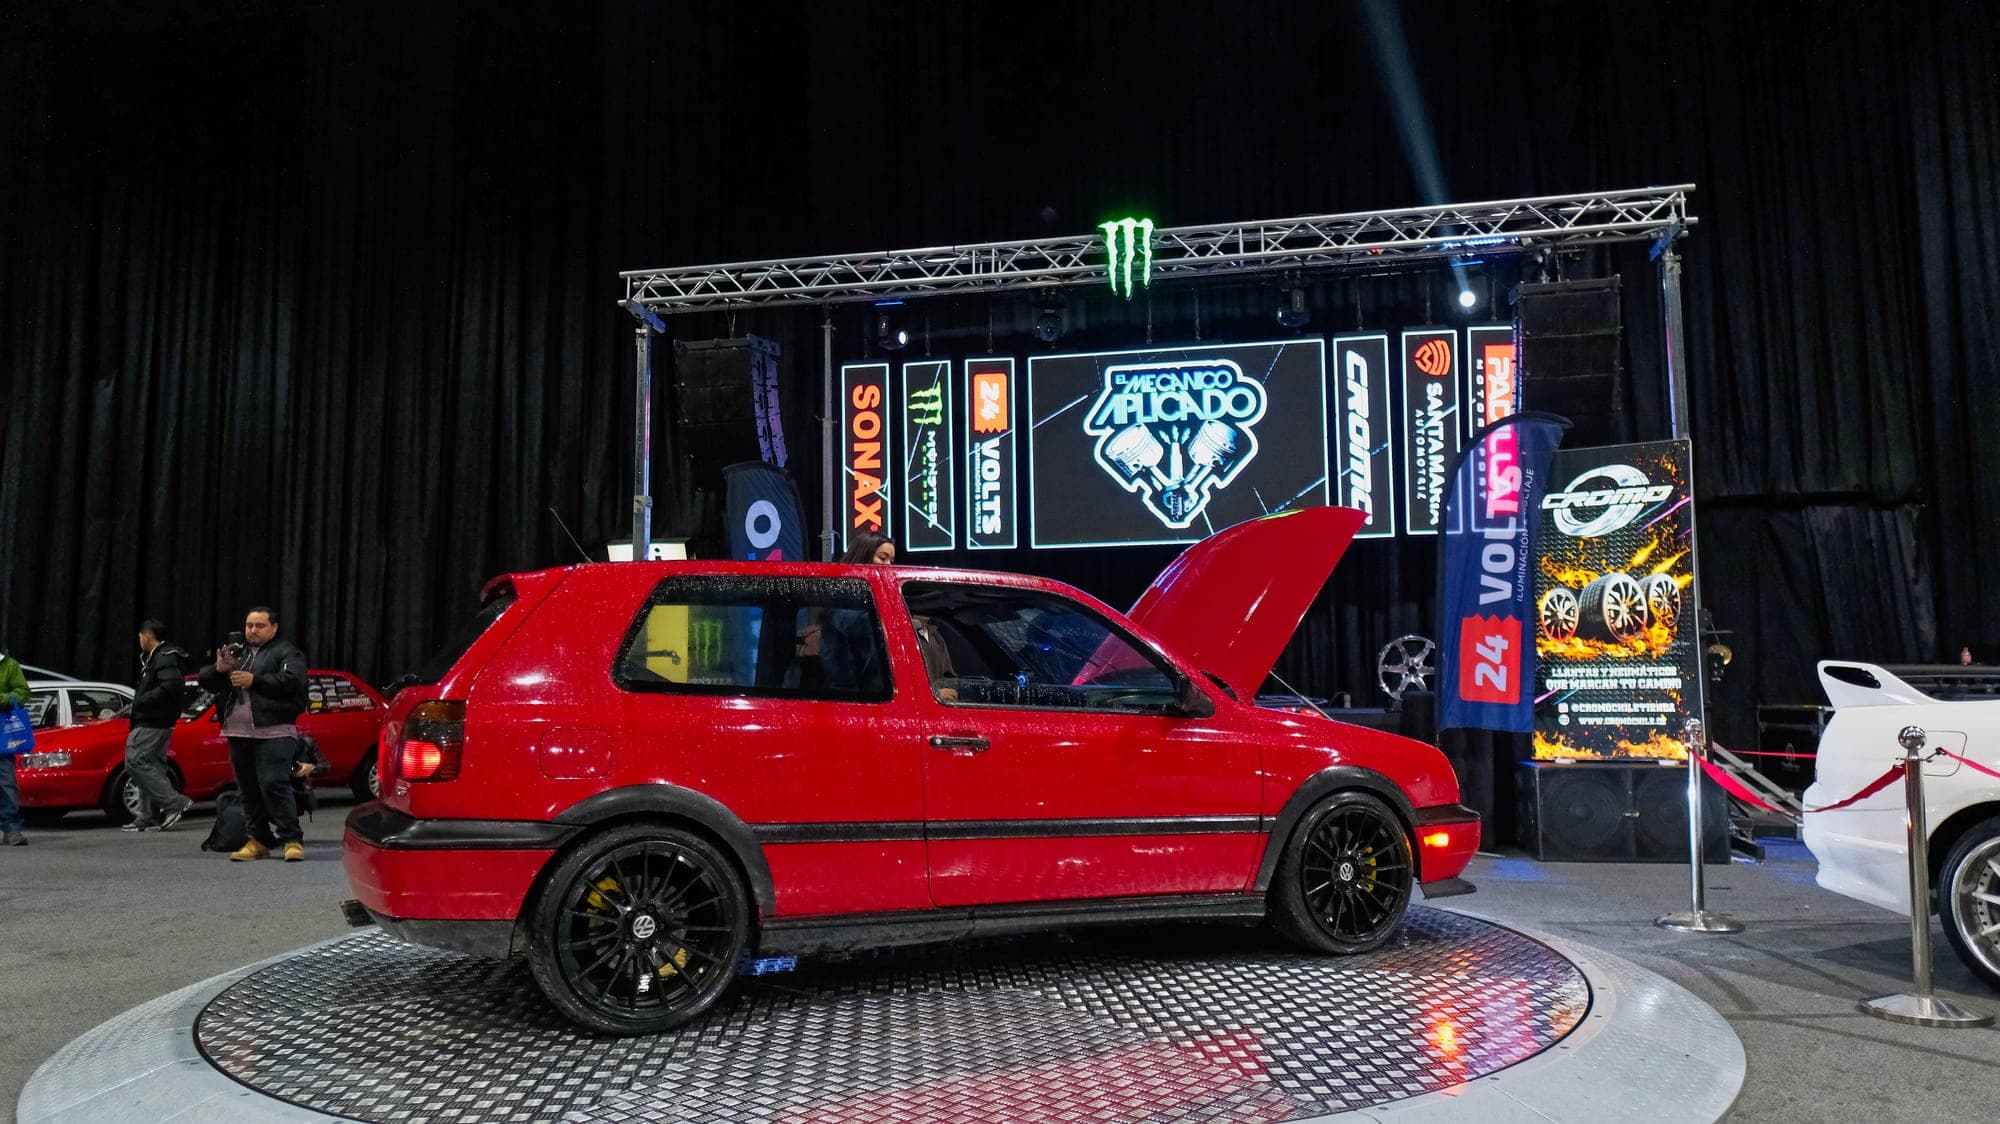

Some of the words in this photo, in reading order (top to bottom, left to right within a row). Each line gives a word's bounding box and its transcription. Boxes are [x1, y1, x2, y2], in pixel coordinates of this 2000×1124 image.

[980, 381, 1000, 420] 24
[1095, 387, 1257, 425] APLICADO
[1114, 374, 1128, 385] EL
[1122, 369, 1233, 394] MECANICO
[852, 384, 882, 529] SONAX
[1415, 409, 1426, 500] AUTOMOTRIZ
[1475, 359, 1486, 500] MOTORPORT
[926, 430, 938, 528] MONSTER
[981, 436, 1002, 535] VOLTS
[1541, 485, 1675, 509] CROMO
[1479, 465, 1522, 605] VOLTS
[1474, 634, 1509, 692] 24
[1545, 679, 1568, 691] QUE
[1569, 679, 1618, 690] MARCAN
[1638, 678, 1682, 690] CAMINO
